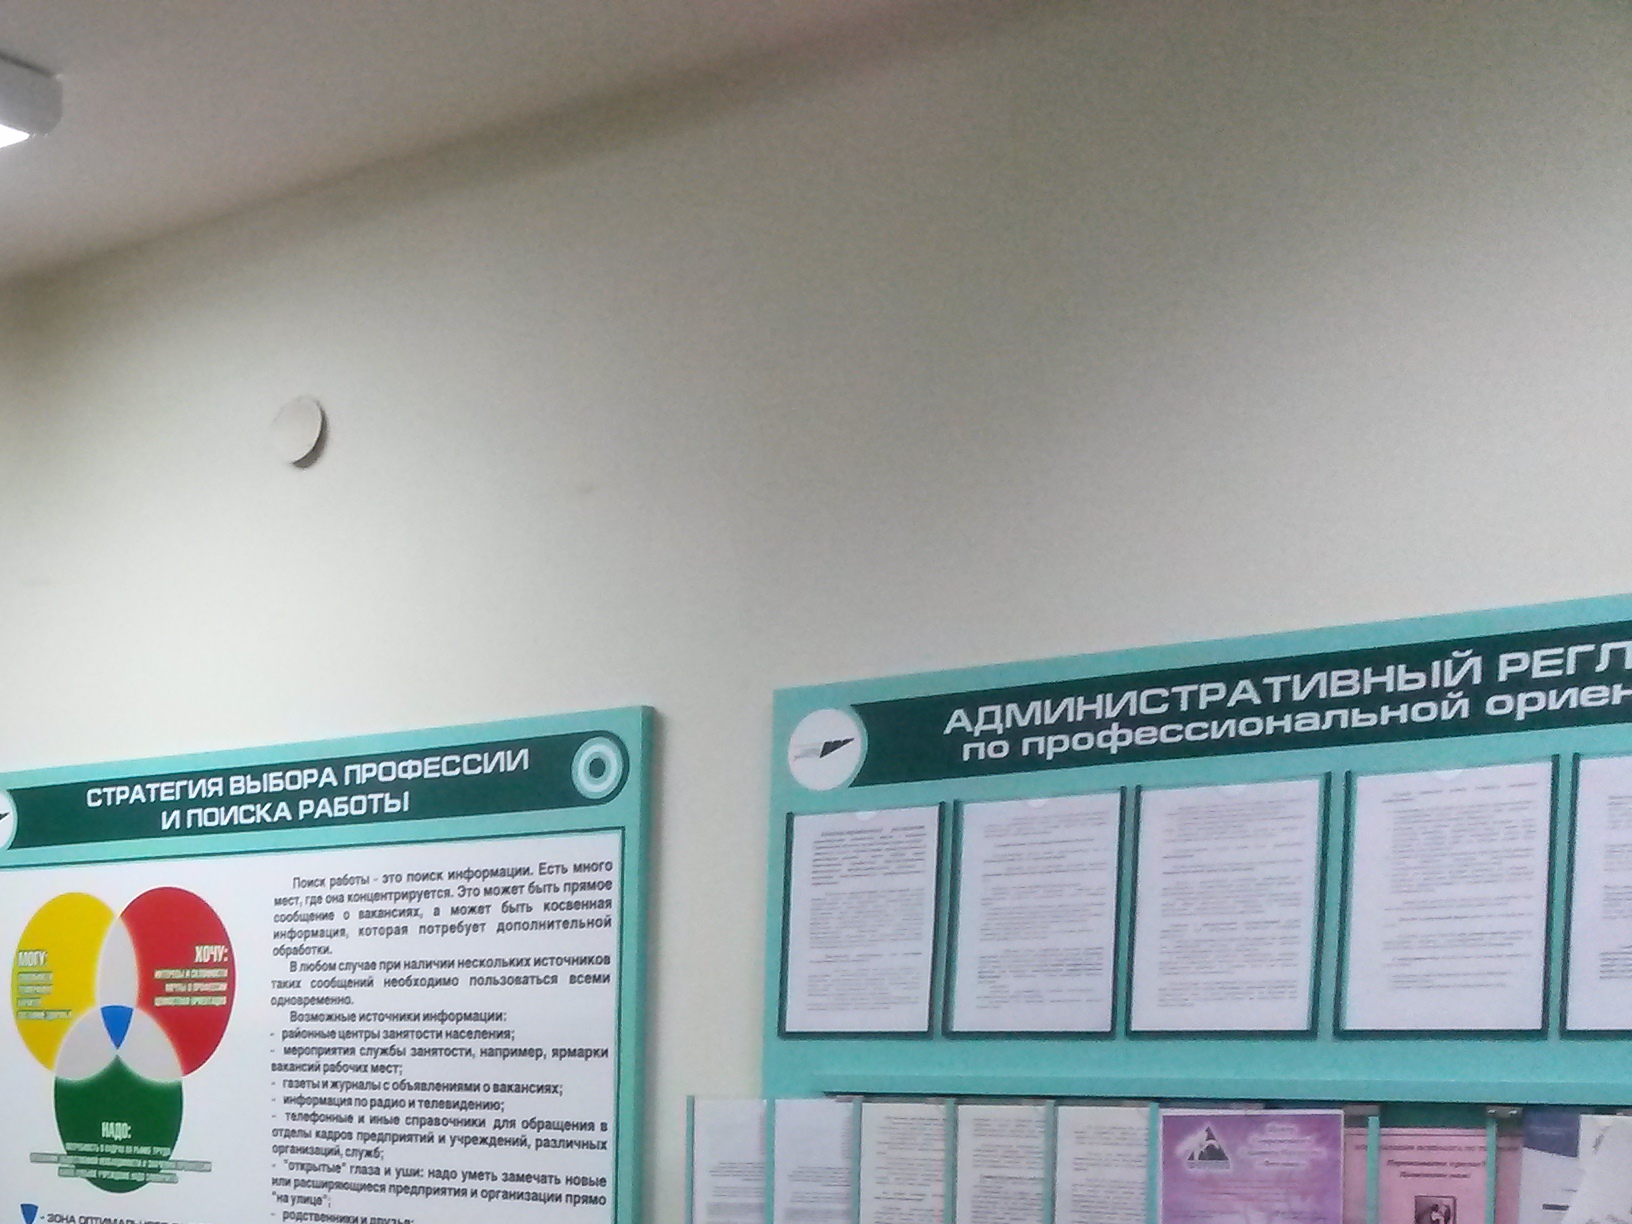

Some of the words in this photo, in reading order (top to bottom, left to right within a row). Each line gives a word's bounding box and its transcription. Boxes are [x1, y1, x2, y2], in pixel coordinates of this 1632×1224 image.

[943, 649, 1483, 737] АДМИНИСТРАТИВНЫЙ
[962, 739, 1010, 762] по
[1021, 691, 1469, 760] профессиональной
[86, 776, 223, 808] СТРАТЕГИЯ
[229, 768, 337, 796] ВЫБОРА
[344, 749, 529, 785] ПРОФЕССИИ
[161, 811, 180, 830] И
[186, 801, 292, 827] ПОИСКА
[298, 791, 409, 820] РАБОТЫ
[293, 878, 325, 889] Поиск
[330, 875, 370, 889] работы
[382, 873, 402, 883] это
[407, 871, 443, 882] поиск
[448, 865, 533, 881] информации.
[539, 862, 568, 876] Есть
[573, 860, 613, 873] много
[305, 893, 322, 906] где
[326, 892, 344, 904] она
[347, 888, 454, 905] концентрируется.
[457, 886, 480, 897] Это
[483, 884, 525, 896] может
[528, 881, 560, 895] быть
[563, 880, 612, 893] прямое
[274, 910, 334, 923] сообщение
[343, 910, 350, 920] о
[359, 906, 423, 920] вакансиях,
[434, 906, 440, 917] а
[451, 903, 491, 916] может
[501, 899, 533, 913] быть
[544, 898, 612, 912] косвенная
[273, 926, 349, 941] информация,
[359, 924, 408, 938] которая
[419, 920, 486, 935] потребует
[497, 915, 612, 933] дополнительной
[195, 946, 229, 963] ХОЧУ:
[272, 943, 332, 957] обработки.
[290, 961, 297, 972] В
[300, 960, 335, 972] любом
[338, 960, 376, 973] случае
[379, 959, 401, 972] при
[403, 957, 455, 970] наличии
[457, 955, 531, 969] нескольких
[534, 954, 610, 967] источников
[272, 979, 301, 989] таких
[311, 975, 374, 989] сообщений
[384, 975, 459, 989] необходимо
[469, 974, 558, 986] пользоваться
[569, 972, 610, 985] всеми
[290, 1010, 356, 1023] Возможные
[359, 1010, 420, 1023] источники
[422, 1010, 507, 1024] информации:
[282, 1027, 336, 1041] районные
[338, 1028, 380, 1042] центры
[383, 1028, 442, 1040] занятости
[445, 1028, 515, 1041] населения;
[284, 1046, 355, 1058] мероприятия
[360, 1045, 406, 1059] службы
[410, 1046, 475, 1060] занятости,
[480, 1047, 547, 1061] например,
[551, 1048, 608, 1062] ярмарки
[271, 1061, 320, 1073] вакансий
[323, 1061, 368, 1076] рабочих
[371, 1063, 402, 1076] мест;
[283, 1080, 320, 1090] газеты
[322, 1080, 328, 1090] и
[330, 1079, 381, 1094] журналы
[383, 1081, 390, 1091] с
[392, 1080, 480, 1094] объявлениями
[483, 1083, 490, 1093] о
[493, 1082, 563, 1097] вакансиях;
[283, 1094, 352, 1109] информация
[354, 1098, 367, 1108] по
[370, 1098, 405, 1111] радио
[408, 1099, 415, 1109] и
[418, 1099, 504, 1113] телевидению;
[102, 1122, 132, 1140] НАДО:
[285, 1112, 353, 1126] телефонные
[358, 1114, 364, 1124] и
[370, 1115, 399, 1125] иные
[405, 1116, 486, 1130] справочники
[493, 1117, 515, 1130] для
[521, 1119, 595, 1133] обращения
[600, 1122, 608, 1132] в
[272, 1128, 312, 1139] отделы
[315, 1130, 353, 1142] кадров
[357, 1131, 434, 1144] предприятий
[438, 1135, 445, 1145] и
[450, 1134, 531, 1150] учреждений,
[535, 1138, 607, 1151] различных
[346, 1147, 383, 1160] служб;
[350, 1166, 381, 1177] глаза
[385, 1167, 391, 1177] и
[395, 1167, 423, 1180] уши:
[428, 1169, 457, 1181] надо
[462, 1170, 497, 1183] уметь
[502, 1172, 561, 1186] замечать
[566, 1175, 607, 1187] новые
[272, 1177, 292, 1187] или
[294, 1178, 385, 1193] расширяющиеся
[389, 1182, 467, 1197] предприятия
[471, 1188, 478, 1197] и
[480, 1188, 562, 1204] организации
[565, 1192, 606, 1207] прямо
[272, 1191, 288, 1204] "на
[47, 1214, 76, 1224] ЗОНА
[361, 1215, 367, 1224] и
